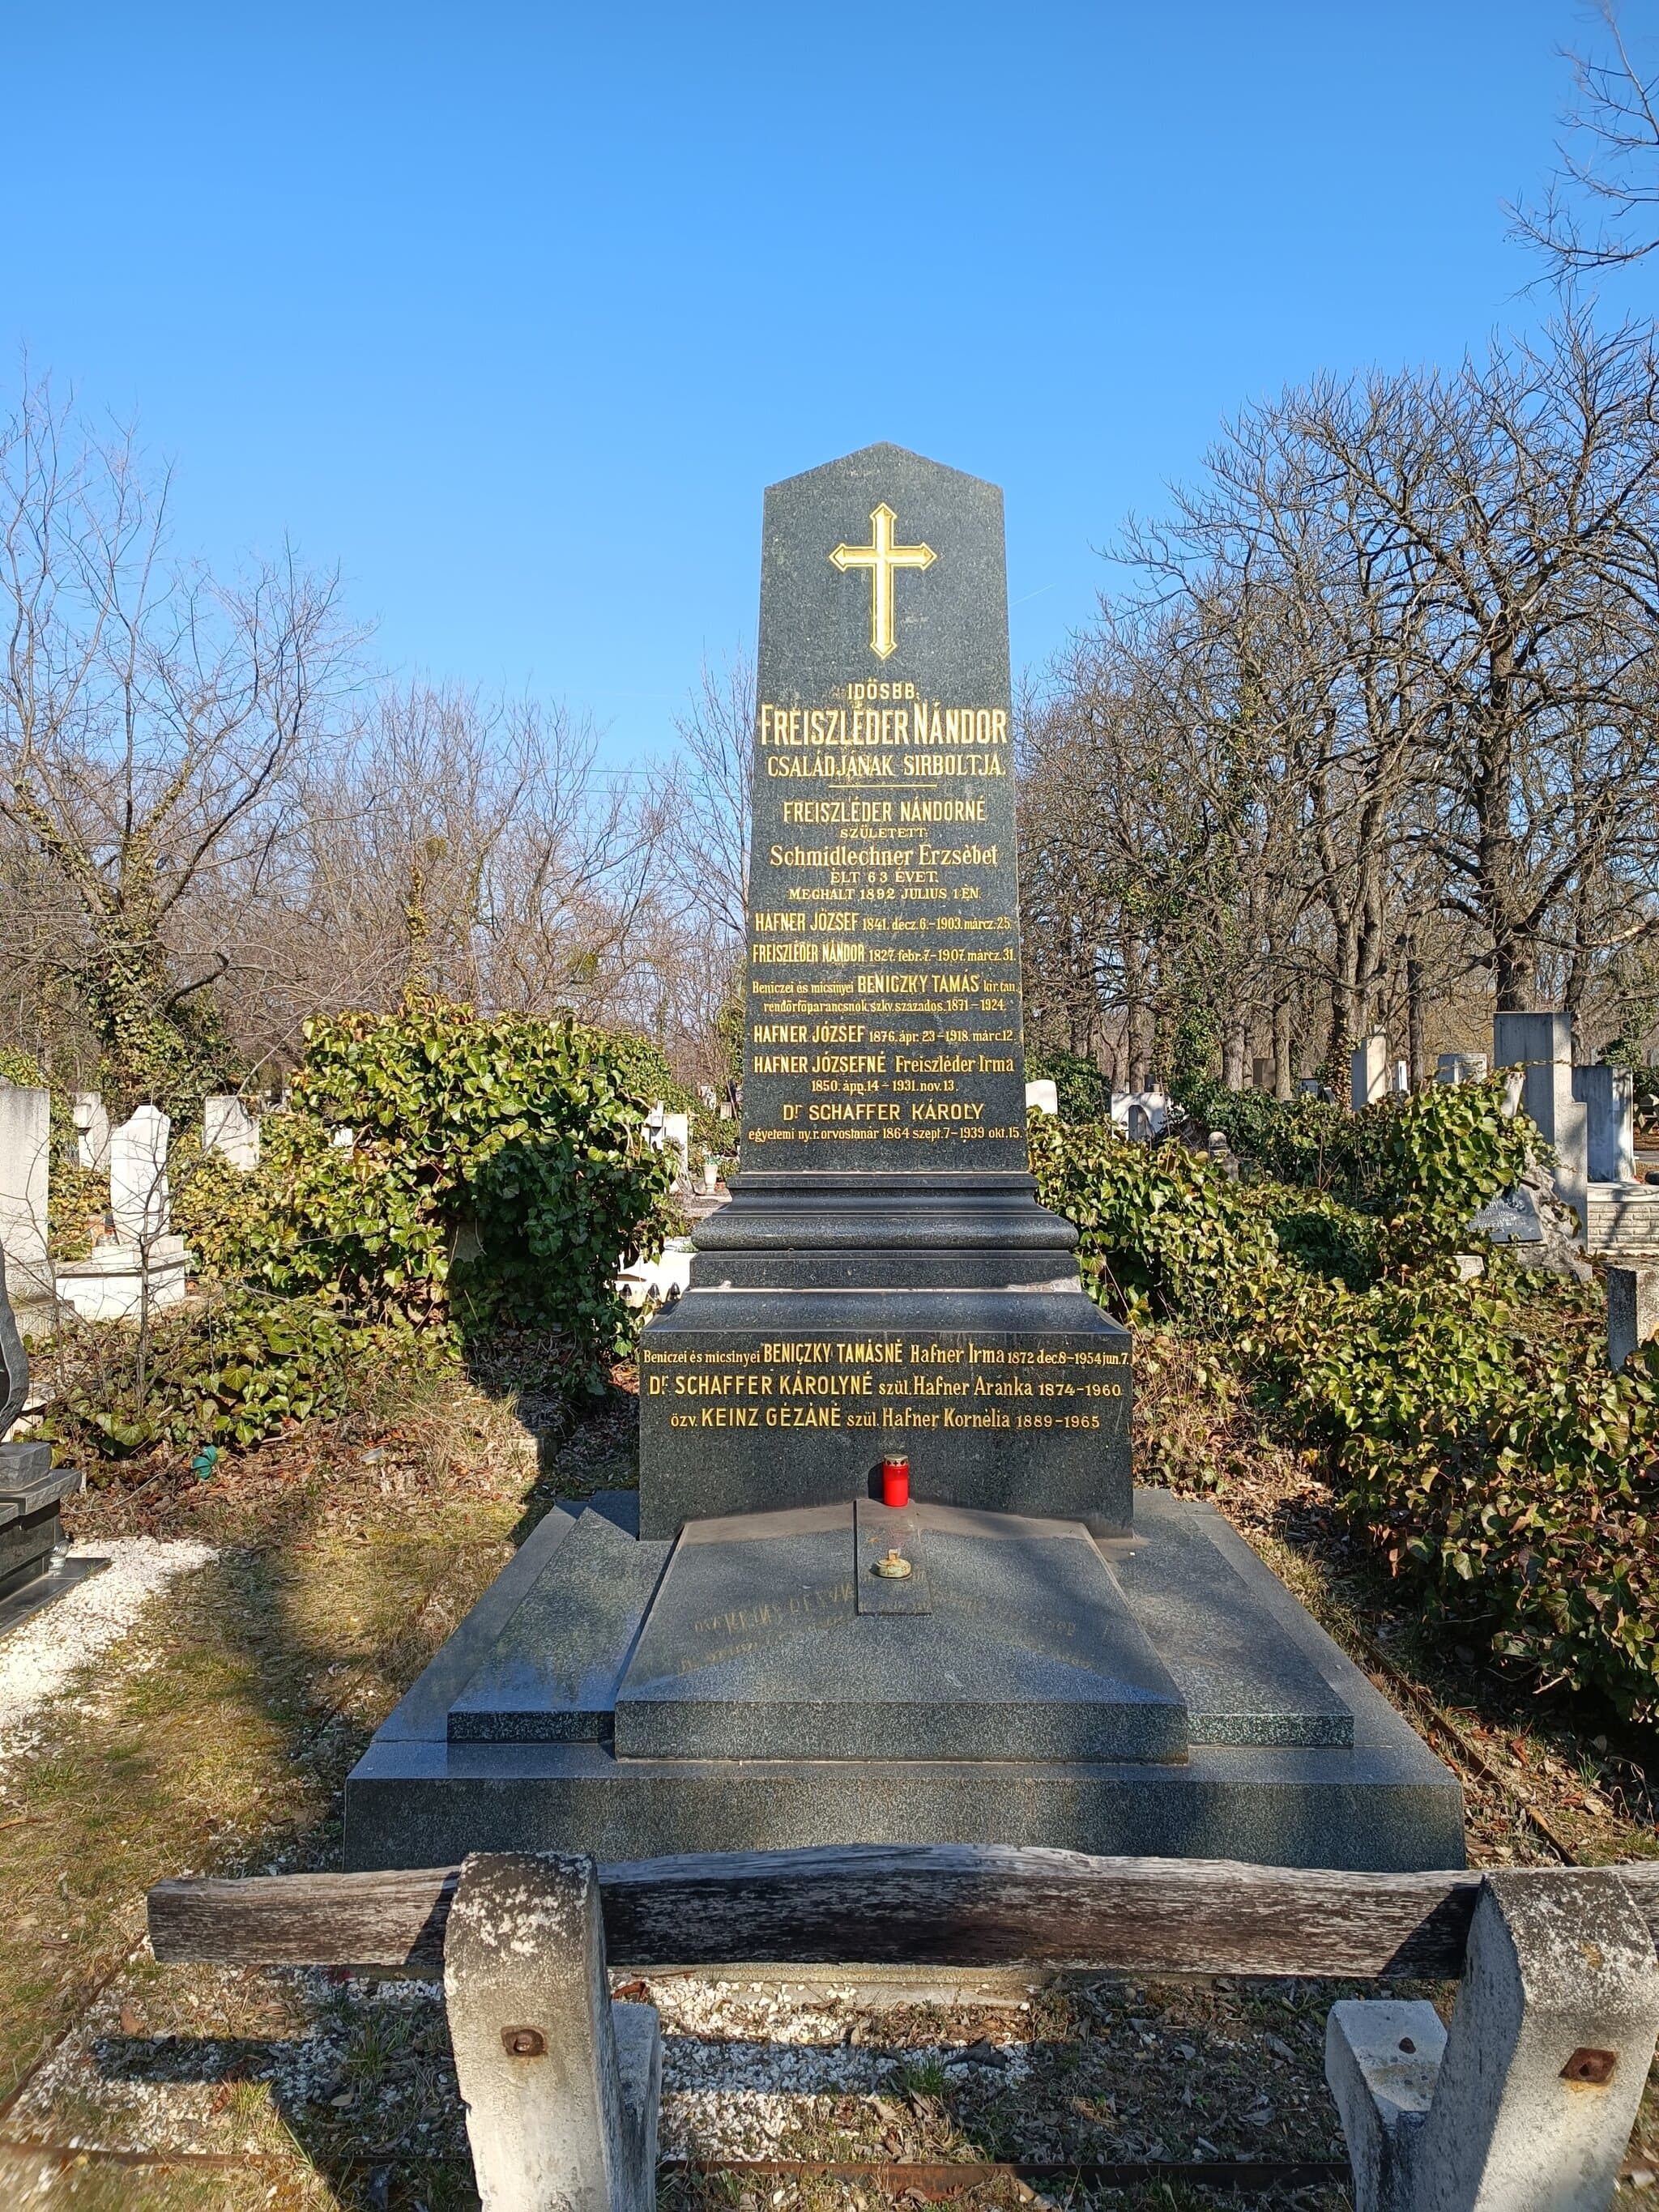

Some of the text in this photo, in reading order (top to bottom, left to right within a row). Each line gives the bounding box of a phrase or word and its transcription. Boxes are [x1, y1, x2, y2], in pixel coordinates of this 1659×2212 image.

[914, 701, 1007, 744] NÁNDOR
[768, 751, 895, 777] CSALÁDJÁNAK
[783, 795, 986, 822] FREISZLÉDER NÁNDORNÉ
[770, 845, 913, 866] Schmidlechner
[788, 888, 855, 900] MEGHALT
[859, 888, 895, 900] 1892
[822, 939, 865, 962] NÁNDOR
[753, 981, 794, 994] Beniczei
[858, 974, 928, 993] BENICZKY
[932, 970, 979, 993] TAMÁS
[753, 1025, 808, 1042] HAFNER
[812, 1021, 865, 1042] JÓZSEF
[753, 1055, 808, 1073] HAFNER
[812, 1051, 886, 1073] JÓZSEFNÉ
[979, 1055, 1014, 1072] Irma
[809, 1104, 901, 1120] SCHAFFER
[912, 1099, 985, 1120] KÁROLY
[882, 1127, 909, 1140] 1864
[644, 1350, 687, 1363] Beniczei
[690, 1352, 702, 1363] és
[705, 1350, 760, 1366] micsinyei
[764, 1343, 831, 1363] BENICZKY
[836, 1339, 903, 1363] TAMÁSNÉ
[911, 1344, 965, 1363] Hafner
[968, 1343, 1005, 1363] Irma
[1008, 1352, 1034, 1364] 1872
[675, 1375, 773, 1395] SCHAFFER
[779, 1370, 872, 1395] KÁROLYNÉ
[913, 1376, 970, 1396] Hafner
[974, 1376, 1033, 1396] Aranka
[702, 1407, 760, 1426] KEINZ
[766, 1403, 841, 1426] GÉZÁNÉ
[882, 1407, 939, 1427] Hafner
[944, 1408, 1011, 1427] Kornélia
